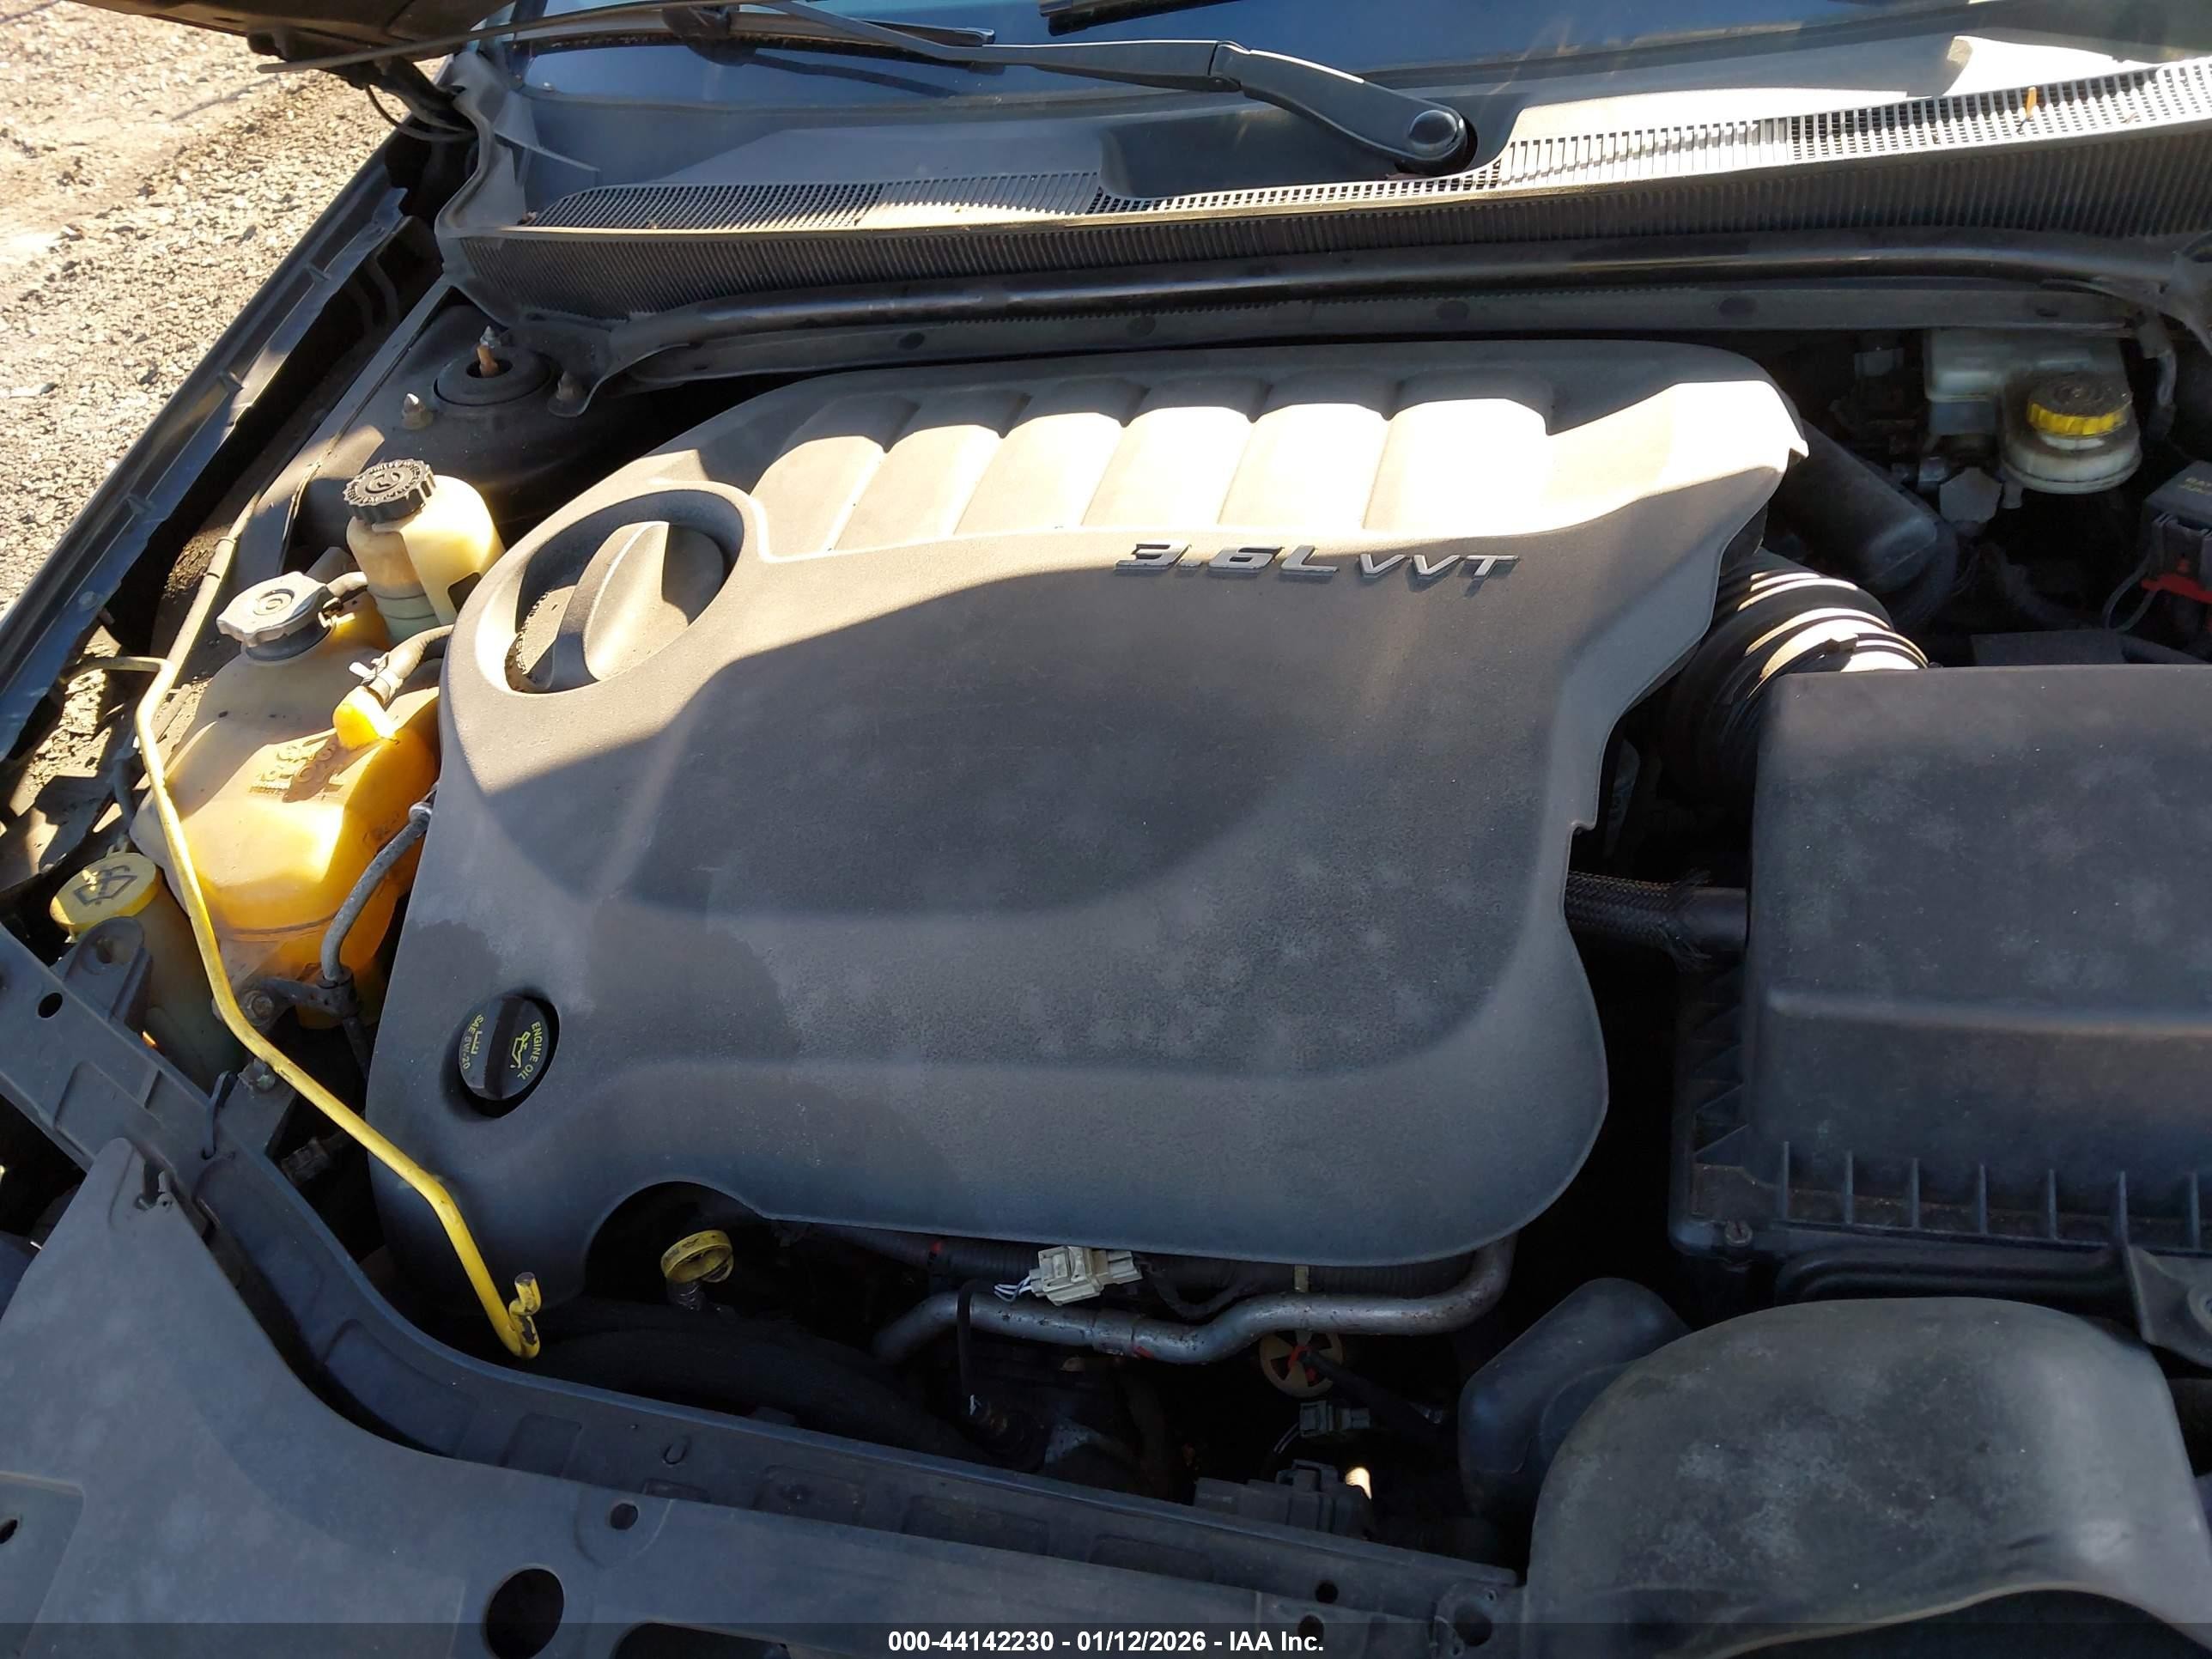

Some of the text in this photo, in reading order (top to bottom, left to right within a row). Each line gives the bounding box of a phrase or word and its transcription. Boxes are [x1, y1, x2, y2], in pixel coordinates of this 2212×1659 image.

[1115, 543, 1519, 579] 3.6L VVT
[468, 1014, 483, 1035] SAE
[517, 1021, 544, 1080] ENGINE OIL
